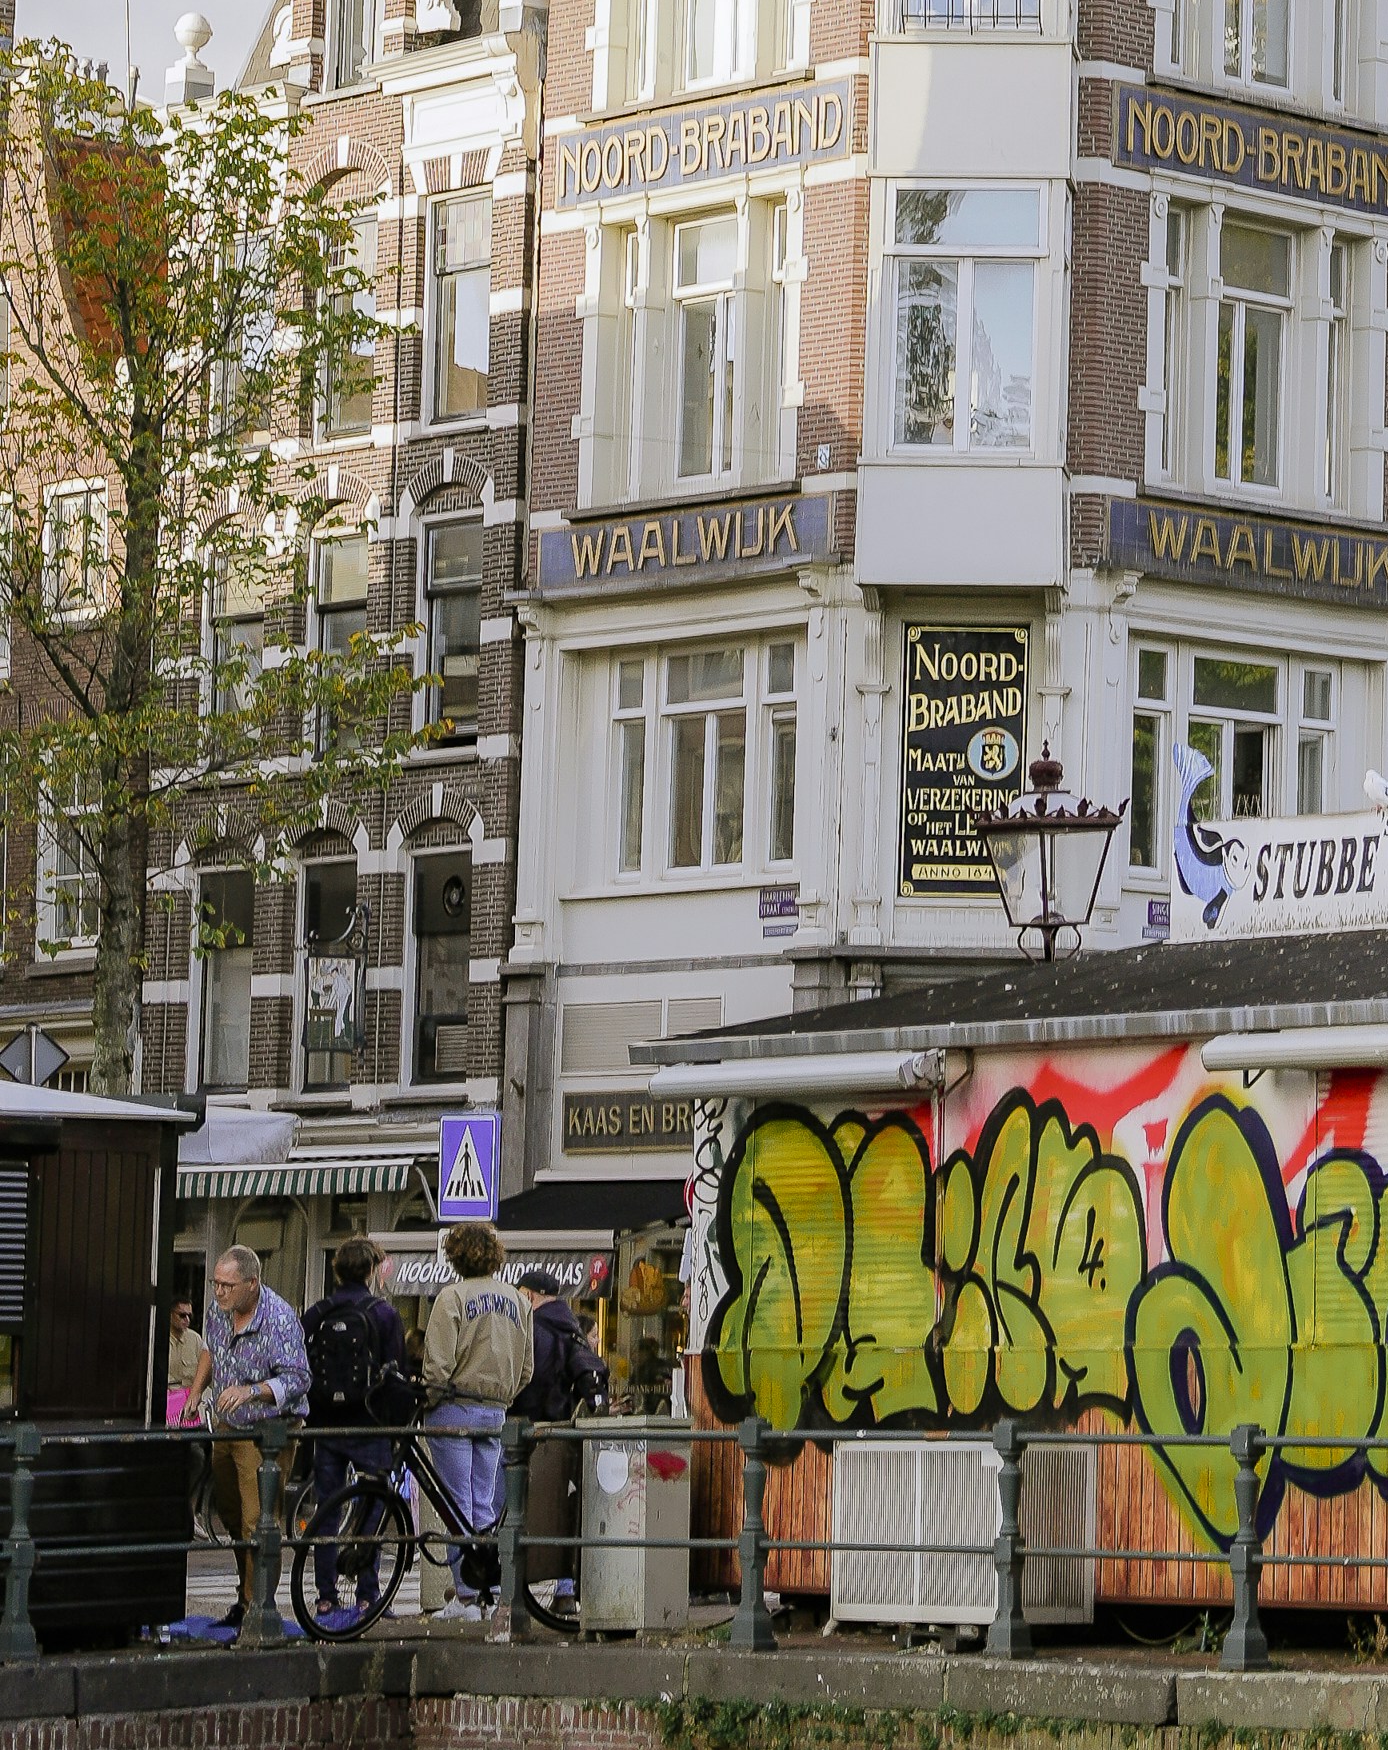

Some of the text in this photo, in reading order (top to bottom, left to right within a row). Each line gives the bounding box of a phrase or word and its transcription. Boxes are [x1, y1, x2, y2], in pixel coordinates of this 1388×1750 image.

[559, 93, 843, 198] NOORD-BRABAND
[571, 503, 799, 579] WAALWIJK
[908, 687, 1022, 732] BRABAND
[953, 775, 975, 786] VAN
[907, 812, 980, 836] OP HET LE
[918, 867, 991, 879] ANNO 184
[569, 1103, 695, 1136] KAAS EN BR
